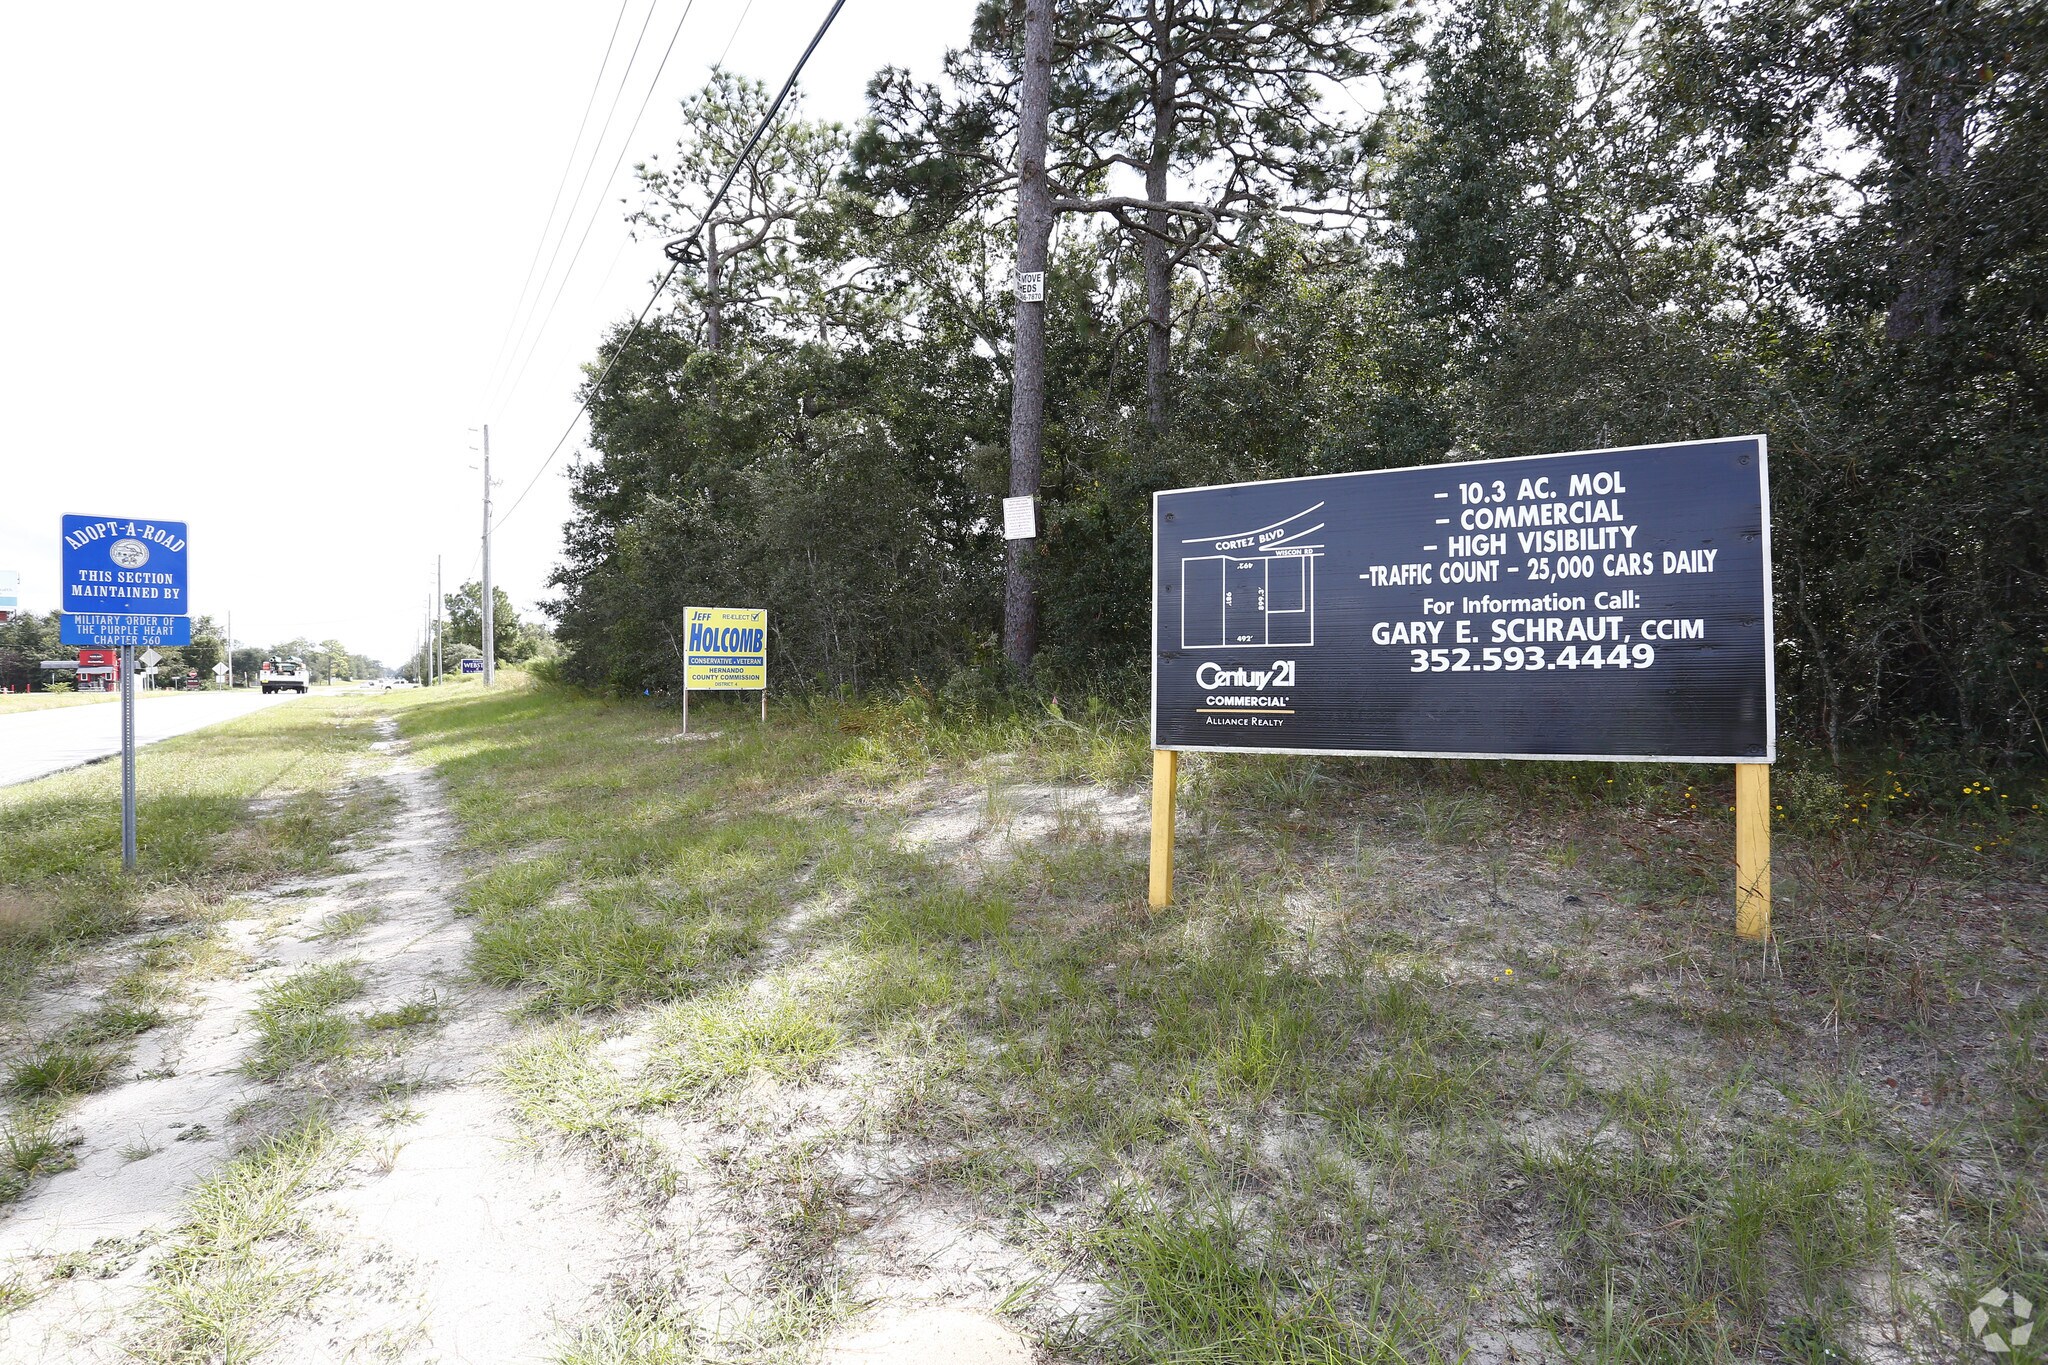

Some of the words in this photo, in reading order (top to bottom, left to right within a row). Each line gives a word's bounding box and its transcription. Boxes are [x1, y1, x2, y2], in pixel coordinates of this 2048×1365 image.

[1459, 480, 1506, 505] 10.3
[1517, 476, 1557, 501] AC.
[1568, 470, 1626, 497] MOL
[1460, 498, 1624, 531] COMMERCIAL
[65, 521, 186, 552] ADOPT-A-ROAD
[1215, 537, 1255, 551] CORTEZ
[1259, 528, 1285, 543] BLVD
[1448, 533, 1507, 558] HIGH
[1517, 525, 1638, 554] VISIBILITY
[79, 569, 112, 582] THIS
[118, 571, 173, 584] SECTION
[1439, 559, 1500, 584] COUNT
[1527, 554, 1595, 584] 25,000
[1602, 551, 1654, 577] CARS
[1662, 548, 1718, 575] DAILY
[71, 584, 159, 599] MAINTAINED
[164, 588, 180, 599] BY
[1423, 597, 1455, 615] For
[1462, 592, 1586, 614] Information
[1594, 589, 1641, 610] Call:
[75, 615, 120, 625] MILITARY
[126, 616, 158, 626] ORDER
[163, 617, 175, 626] OF
[691, 611, 712, 621] JEFF
[77, 624, 95, 635] THE
[101, 625, 139, 635] PURPLE
[144, 626, 174, 636] HEART
[94, 635, 138, 645] CHAPTER
[142, 636, 161, 645] 560
[689, 623, 764, 653] HOLCOMB
[1371, 620, 1445, 645] GARY
[1456, 619, 1479, 644] E.
[1491, 615, 1631, 644] SCHRAUT,
[1640, 618, 1704, 640] CCIM
[690, 657, 733, 665] CONSERVATIVE
[1410, 643, 1655, 672] 352.593.4449
[1196, 661, 1274, 691] Century
[1271, 660, 1295, 687] 21
[1206, 695, 1286, 707] COMMERCIAL
[1205, 715, 1249, 726] ALLIANCE
[1251, 716, 1284, 727] REALTY
